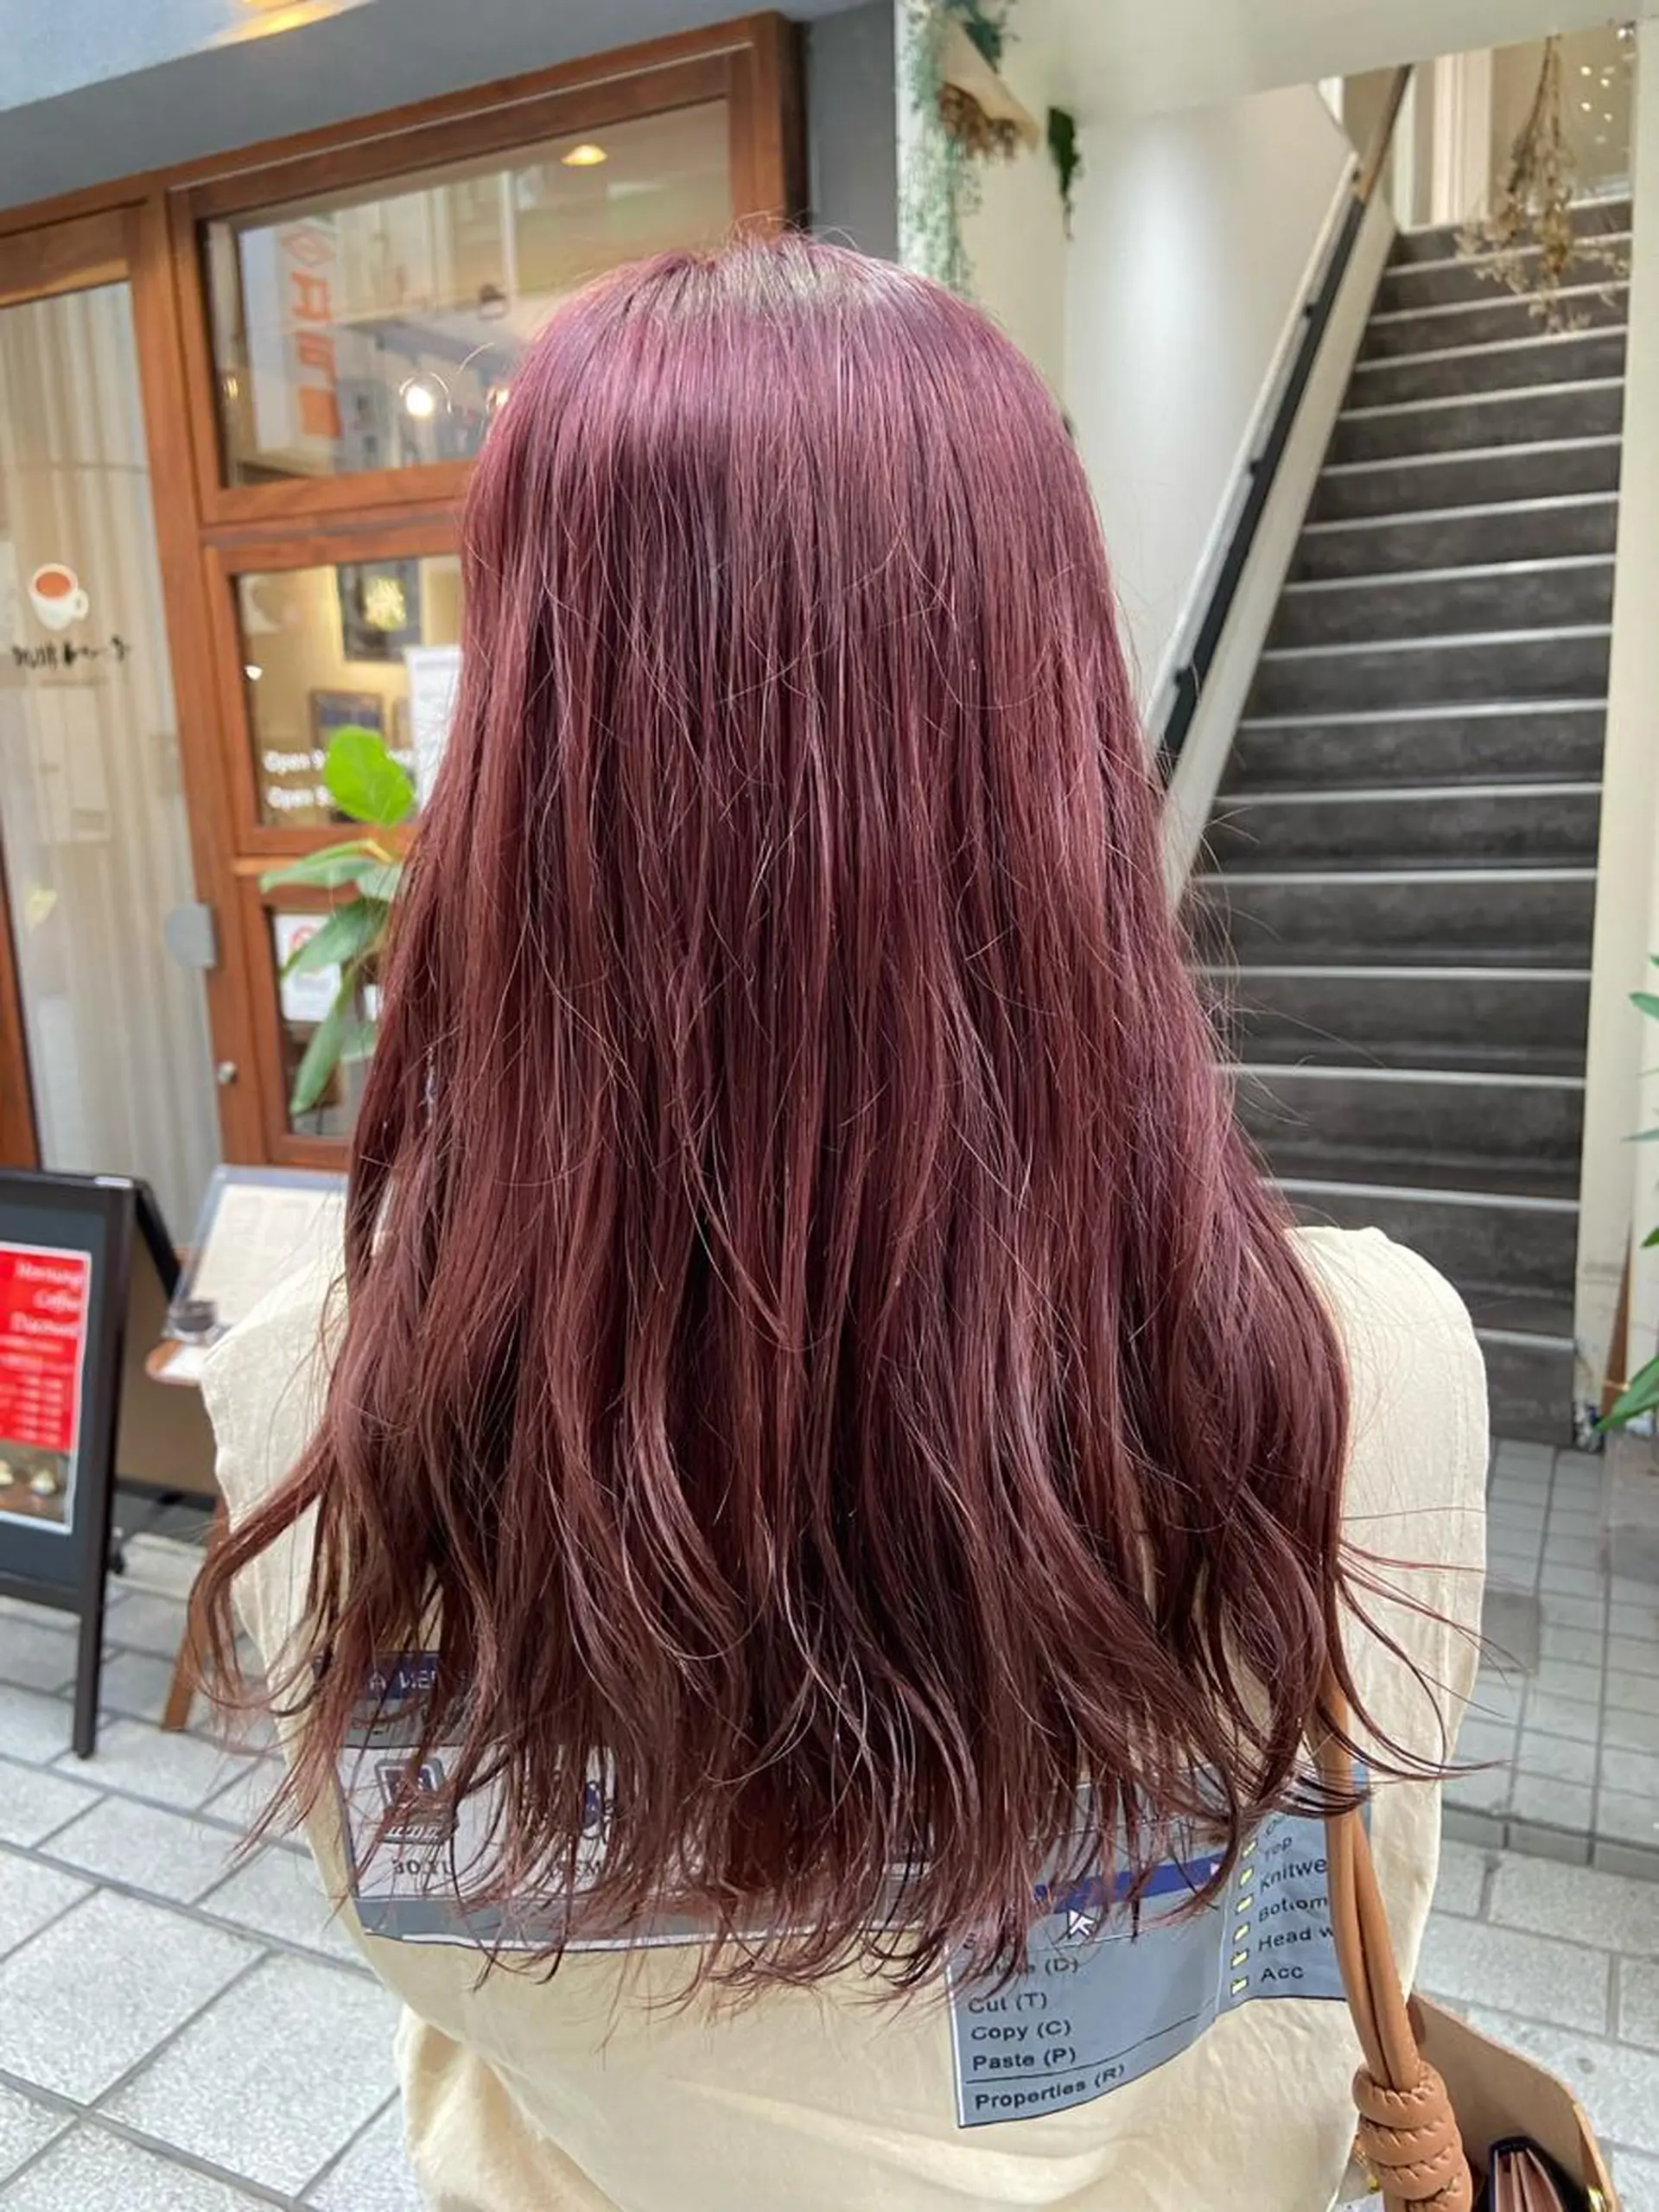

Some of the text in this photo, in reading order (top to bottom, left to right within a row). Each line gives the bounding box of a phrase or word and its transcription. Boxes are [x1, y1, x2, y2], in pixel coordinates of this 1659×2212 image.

[1259, 1859, 1327, 1893] Knitwe
[1258, 1925, 1312, 1952] Head
[1261, 1966, 1305, 1982] Acc
[1016, 1992, 1047, 2011] (T)
[971, 2019, 1071, 2041] Copy (C)
[973, 2047, 1077, 2071] Paste (P)
[975, 2063, 1125, 2110] Properties (R)
